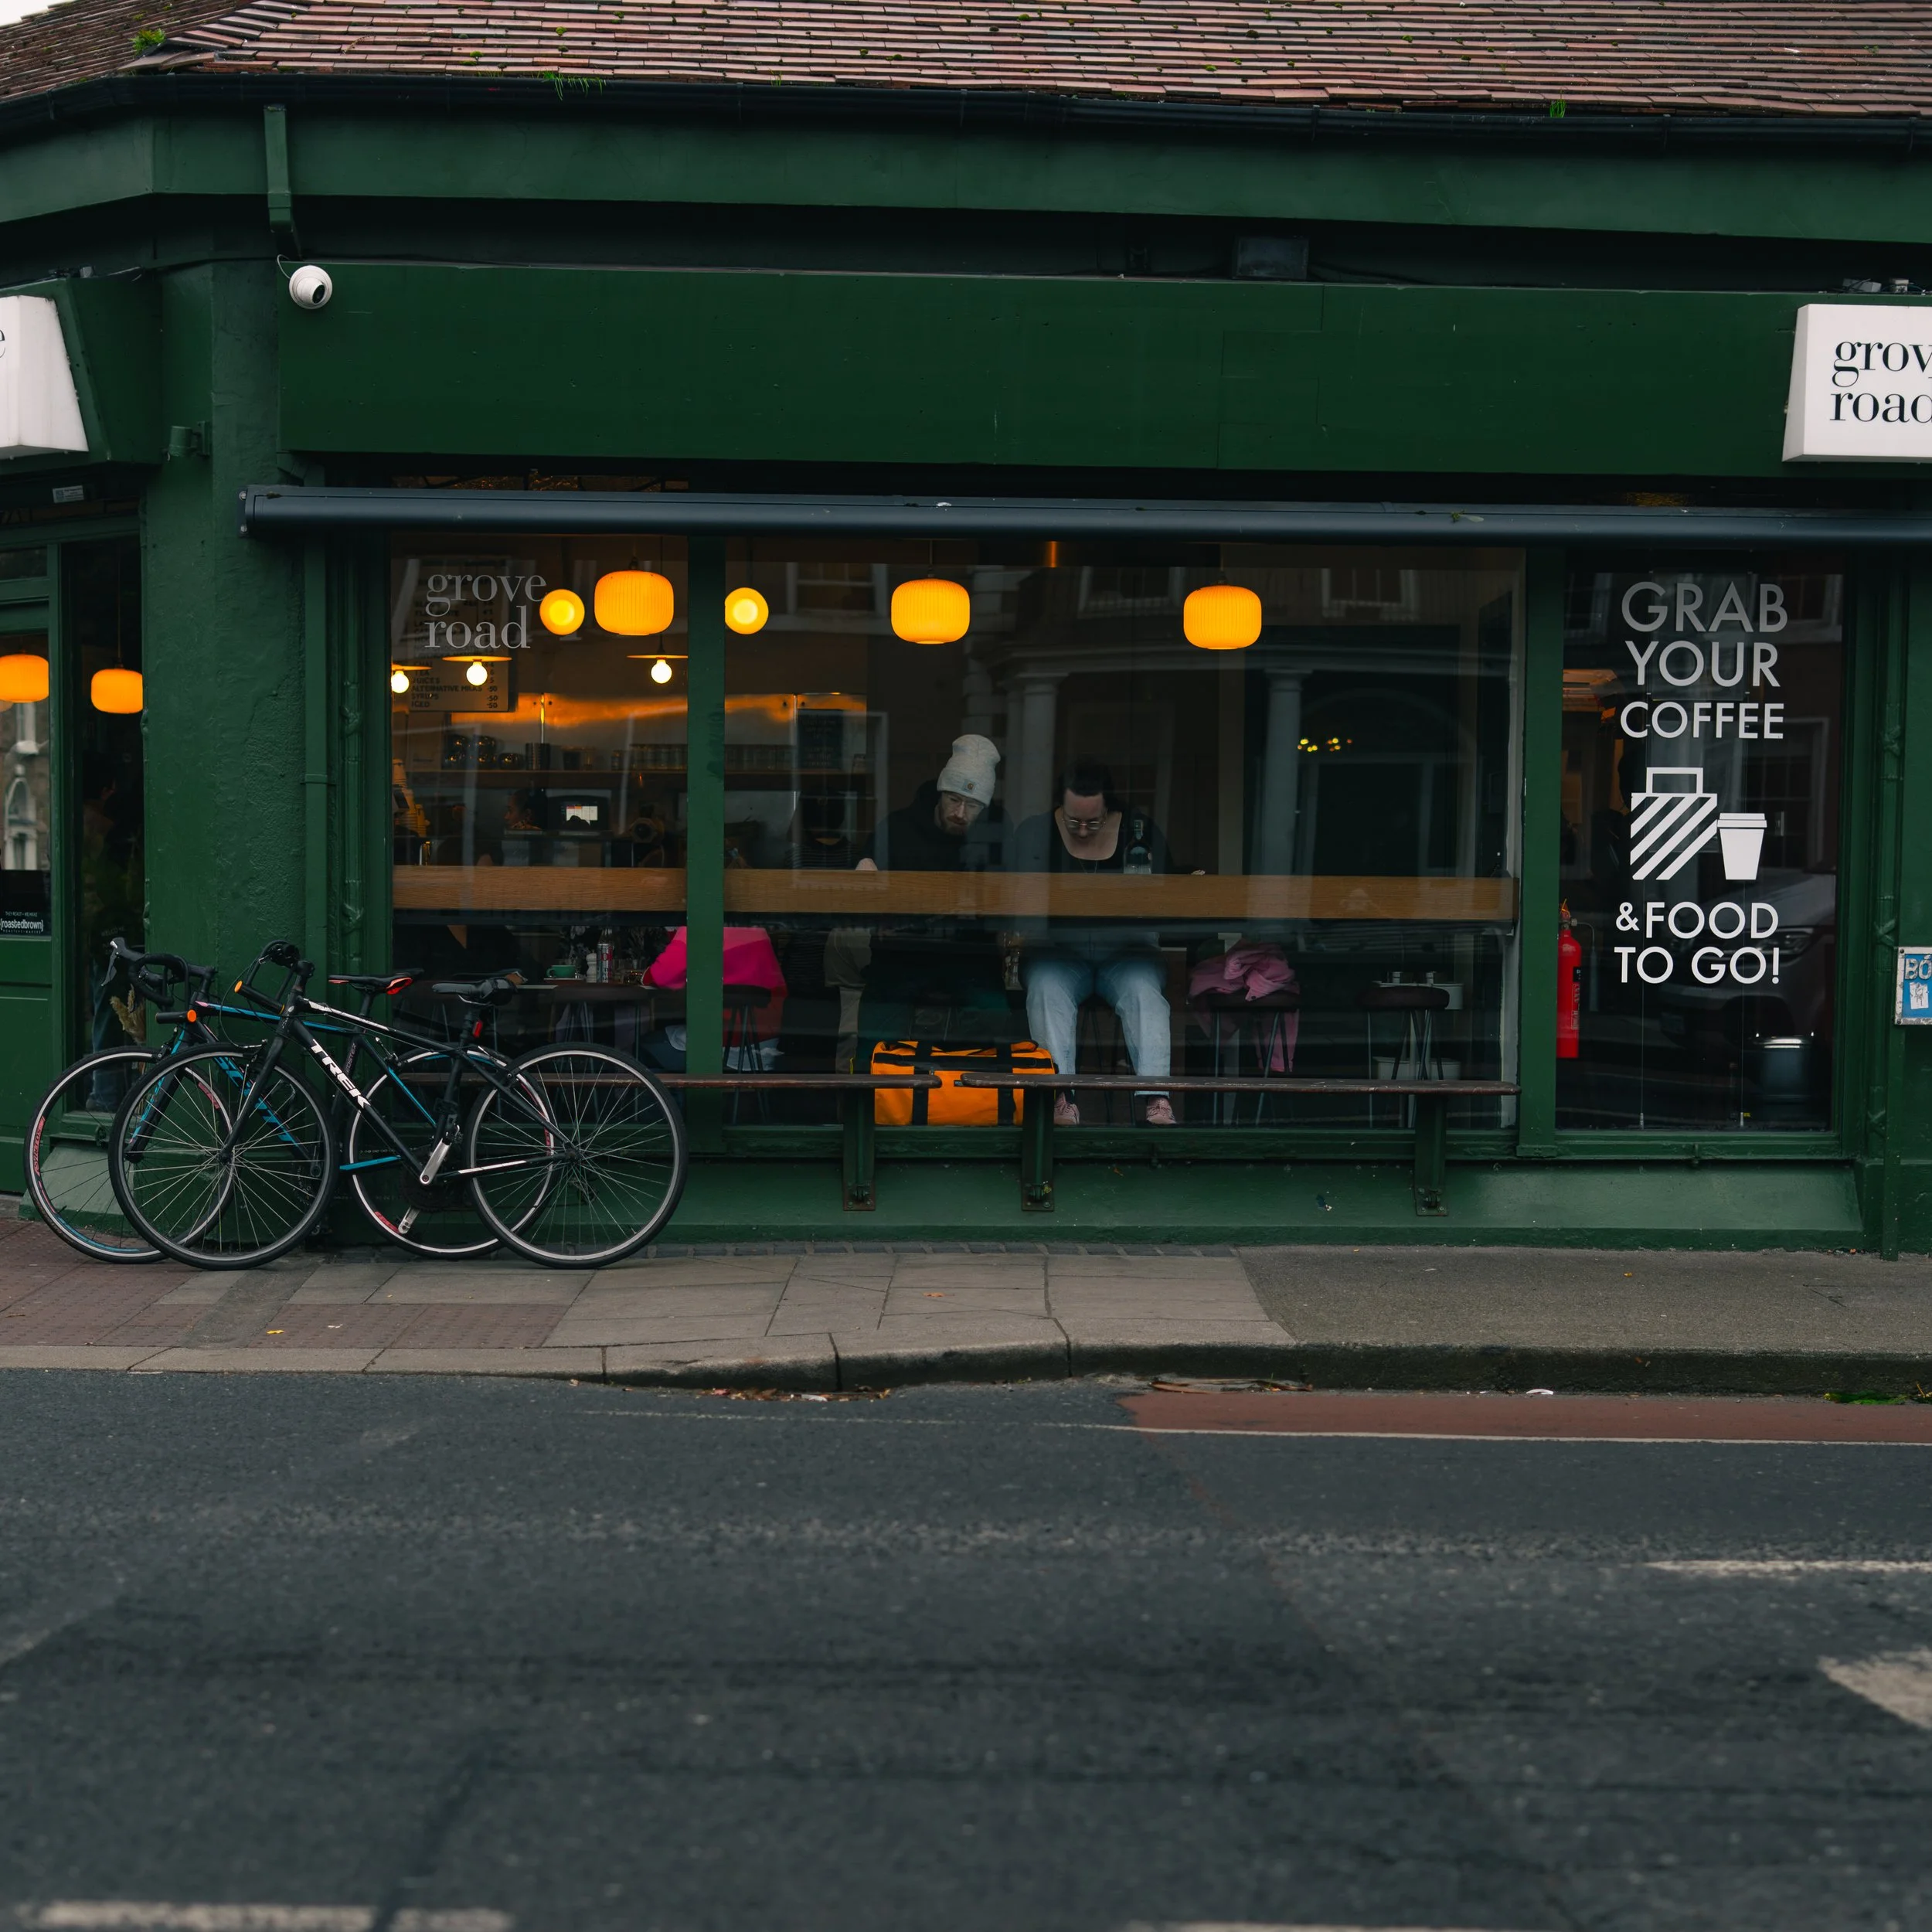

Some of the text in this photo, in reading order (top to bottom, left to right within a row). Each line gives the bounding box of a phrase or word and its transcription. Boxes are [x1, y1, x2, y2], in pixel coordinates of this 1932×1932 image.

[425, 574, 547, 617] grove
[1622, 581, 1787, 633] GRAB
[424, 605, 531, 649] road
[1626, 641, 1781, 687] YOUR
[1621, 702, 1784, 739] COFFEE
[1614, 946, 1780, 985] TO GO!
[310, 1039, 372, 1110] TREK
